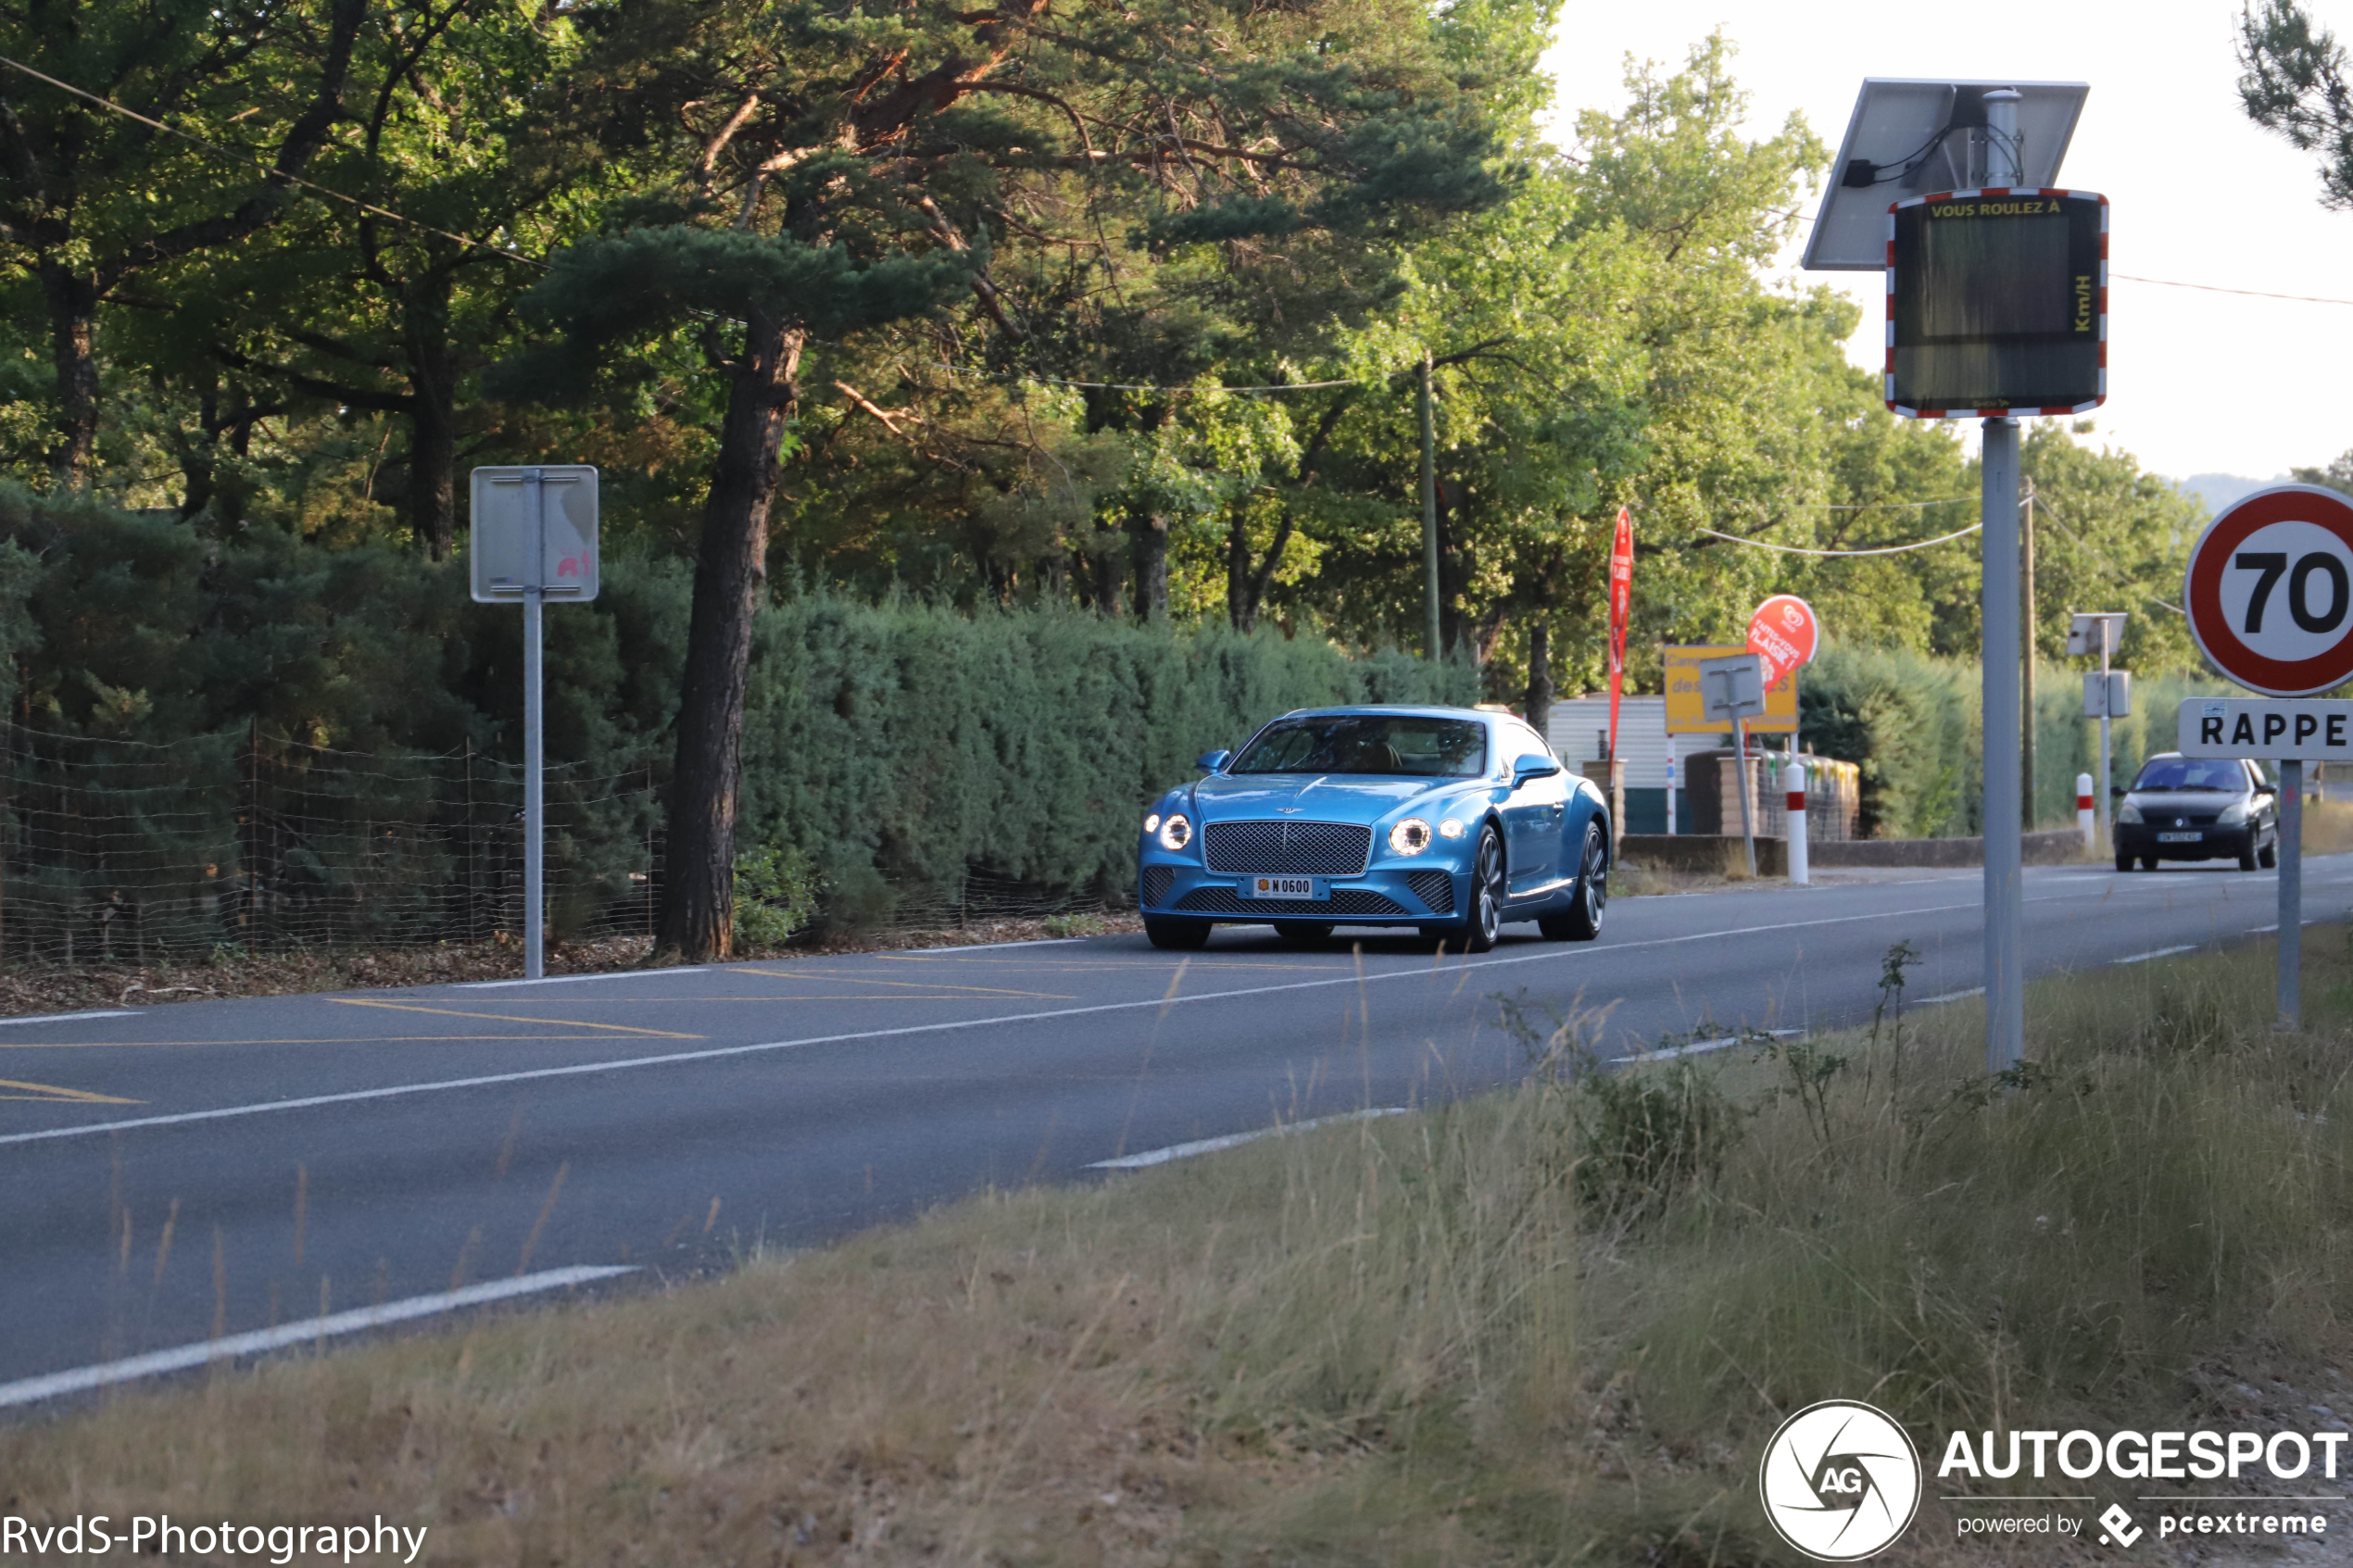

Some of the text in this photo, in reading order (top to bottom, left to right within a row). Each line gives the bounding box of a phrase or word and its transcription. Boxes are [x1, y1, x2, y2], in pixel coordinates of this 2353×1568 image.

[1931, 198, 2061, 218] VOUS ROULEZ À
[2075, 275, 2091, 332] Km/H
[2235, 552, 2349, 633] 70
[1273, 880, 1309, 893] N 0600
